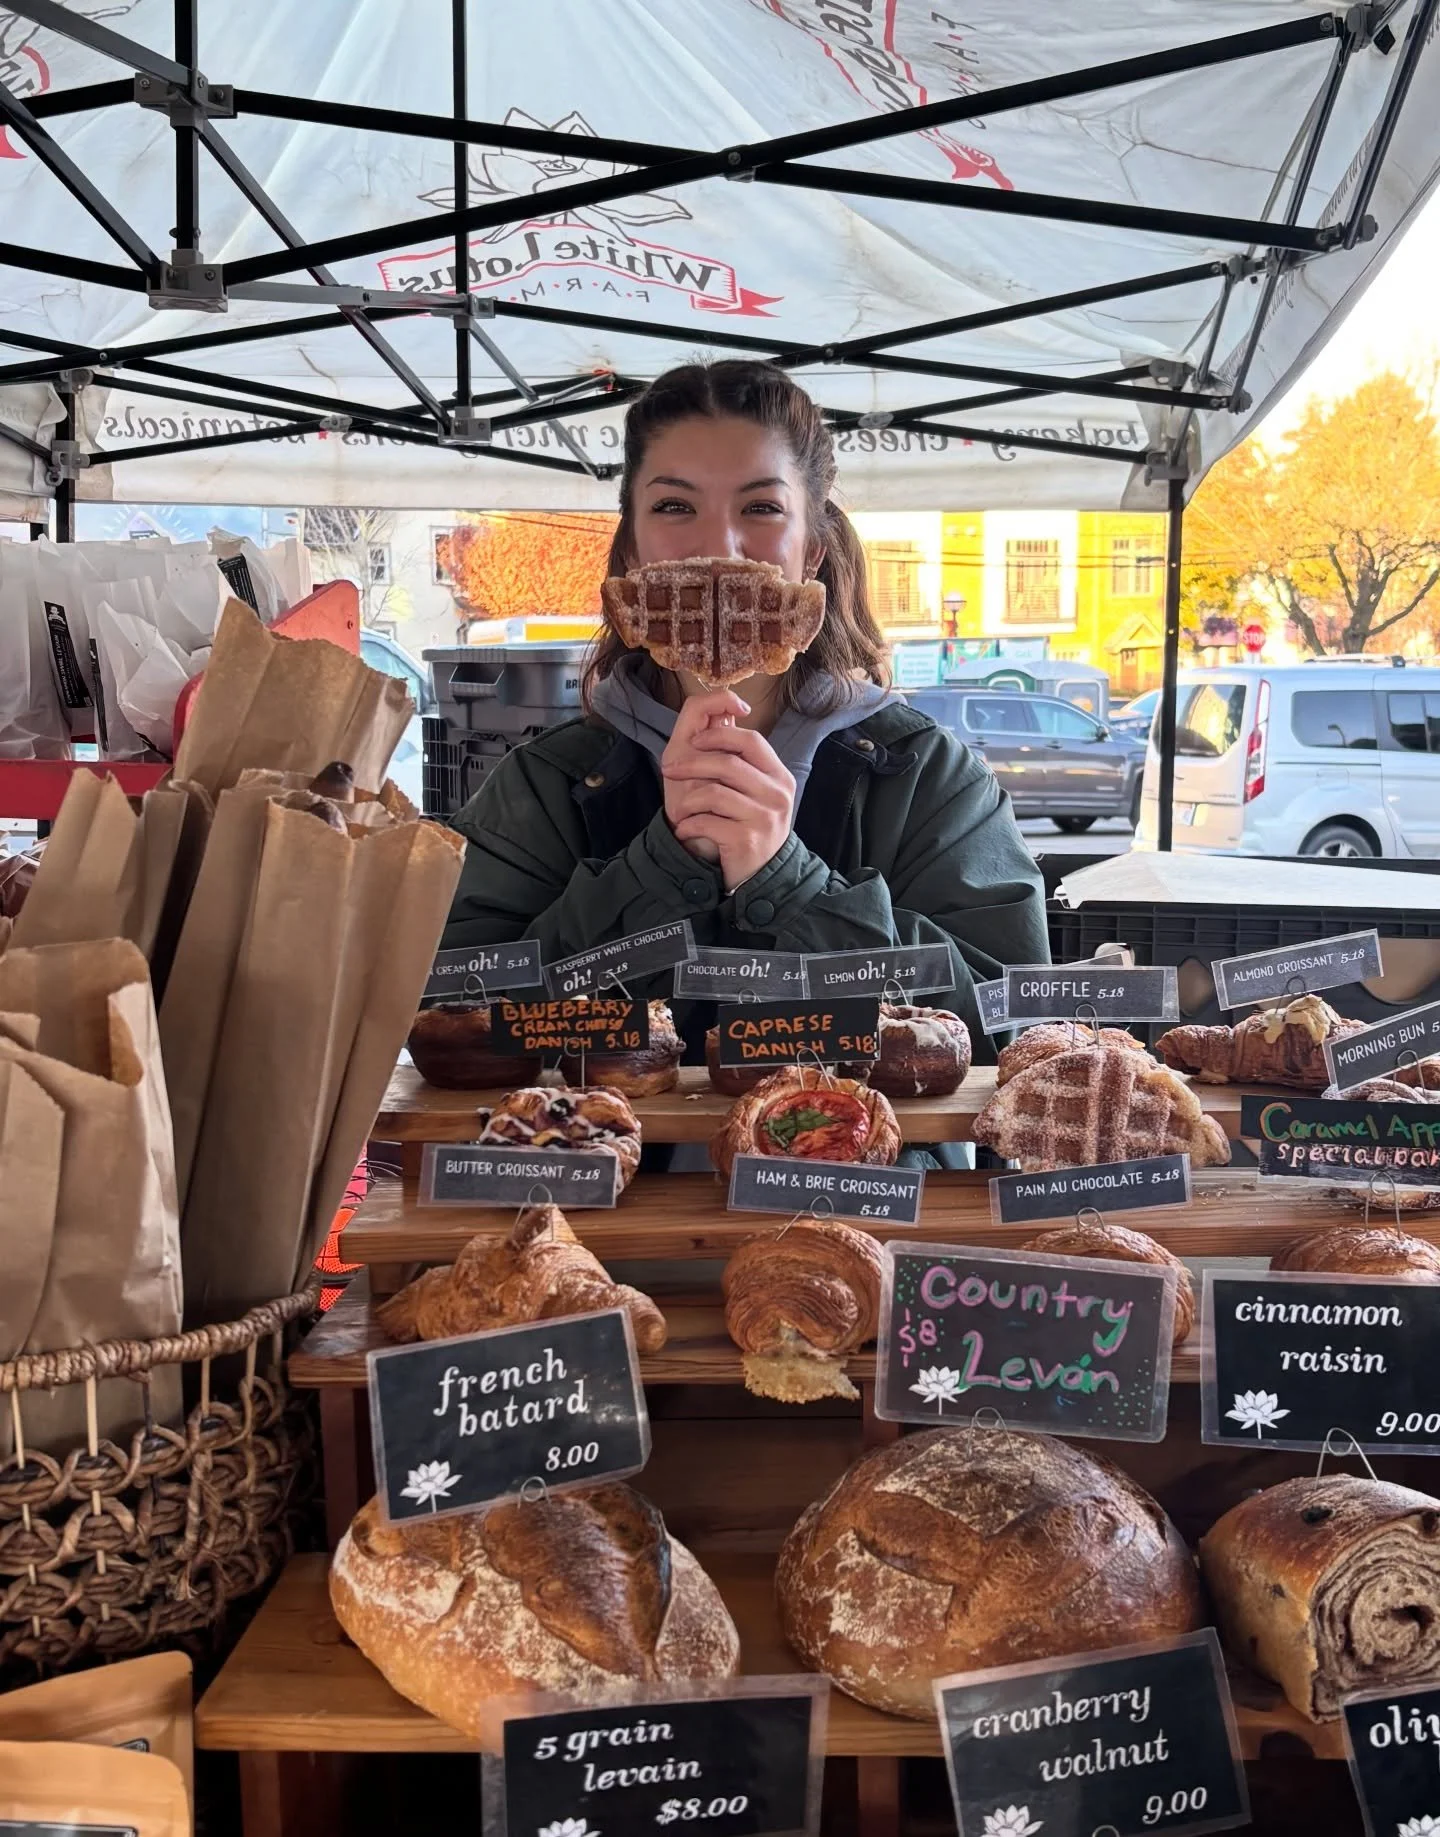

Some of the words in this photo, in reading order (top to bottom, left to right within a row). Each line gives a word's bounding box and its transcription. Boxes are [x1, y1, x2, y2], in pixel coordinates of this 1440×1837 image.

[436, 964, 466, 976] CREAM
[468, 951, 499, 972] oh!
[507, 956, 531, 969] 5.18
[555, 951, 602, 975] RASPBERRY
[603, 940, 633, 957] WHITE
[633, 925, 684, 948] CHOCOLATE
[1232, 964, 1274, 983] ALMOND
[1276, 953, 1335, 975] CROISSANT
[1340, 948, 1365, 965] 5.18
[562, 968, 593, 993] oh!
[604, 961, 629, 980] 5.18
[686, 963, 737, 977] CHOCOLATE
[739, 958, 771, 978] oh!
[823, 970, 855, 985] LEMON
[857, 960, 886, 981] oh!
[893, 966, 916, 980] 5.18
[1020, 981, 1091, 998] CROFFLE
[1097, 986, 1125, 999] 5.18
[502, 1000, 634, 1022] BLUEBERRY
[728, 1014, 834, 1039] CAPRESE
[510, 1019, 572, 1037] CREAM
[524, 1036, 593, 1050] DANISH
[604, 1030, 641, 1049] 5.18
[741, 1039, 825, 1059] DANISH
[838, 1035, 876, 1053] 5.18
[1336, 1034, 1396, 1067] MORNING
[1398, 1021, 1426, 1044] BUN
[1259, 1102, 1380, 1143] Caramel
[1387, 1114, 1440, 1147] App
[445, 1160, 493, 1175] BUTTER
[496, 1162, 565, 1179] CROISSANT
[570, 1168, 601, 1182] 5.18
[1277, 1143, 1382, 1168] special
[756, 1170, 787, 1187] HAM
[790, 1174, 801, 1188] &
[805, 1174, 836, 1192] BRIE
[840, 1178, 917, 1200] CROISSANT
[1016, 1183, 1045, 1199] PAIN
[1050, 1180, 1068, 1195] AU
[1071, 1171, 1144, 1192] CHOCOLATE
[1150, 1168, 1181, 1185] 5.18
[859, 1204, 891, 1217] 5.18
[920, 1265, 1135, 1358] Country
[1234, 1295, 1403, 1327] cinnamon
[958, 1330, 1120, 1395] Levain
[1279, 1345, 1387, 1374] raisin
[433, 1347, 567, 1417] french
[458, 1379, 589, 1438] batard
[1375, 1411, 1440, 1437] 9.00
[545, 1441, 600, 1472] 8.00
[972, 1686, 1152, 1739] cranberry
[1369, 1704, 1440, 1748] oliv
[532, 1736, 559, 1760] 5
[562, 1719, 675, 1762] grain
[1039, 1728, 1170, 1782] walnut
[583, 1756, 703, 1793] levain
[655, 1795, 749, 1826] $8.00
[1141, 1786, 1209, 1825] 9.00
